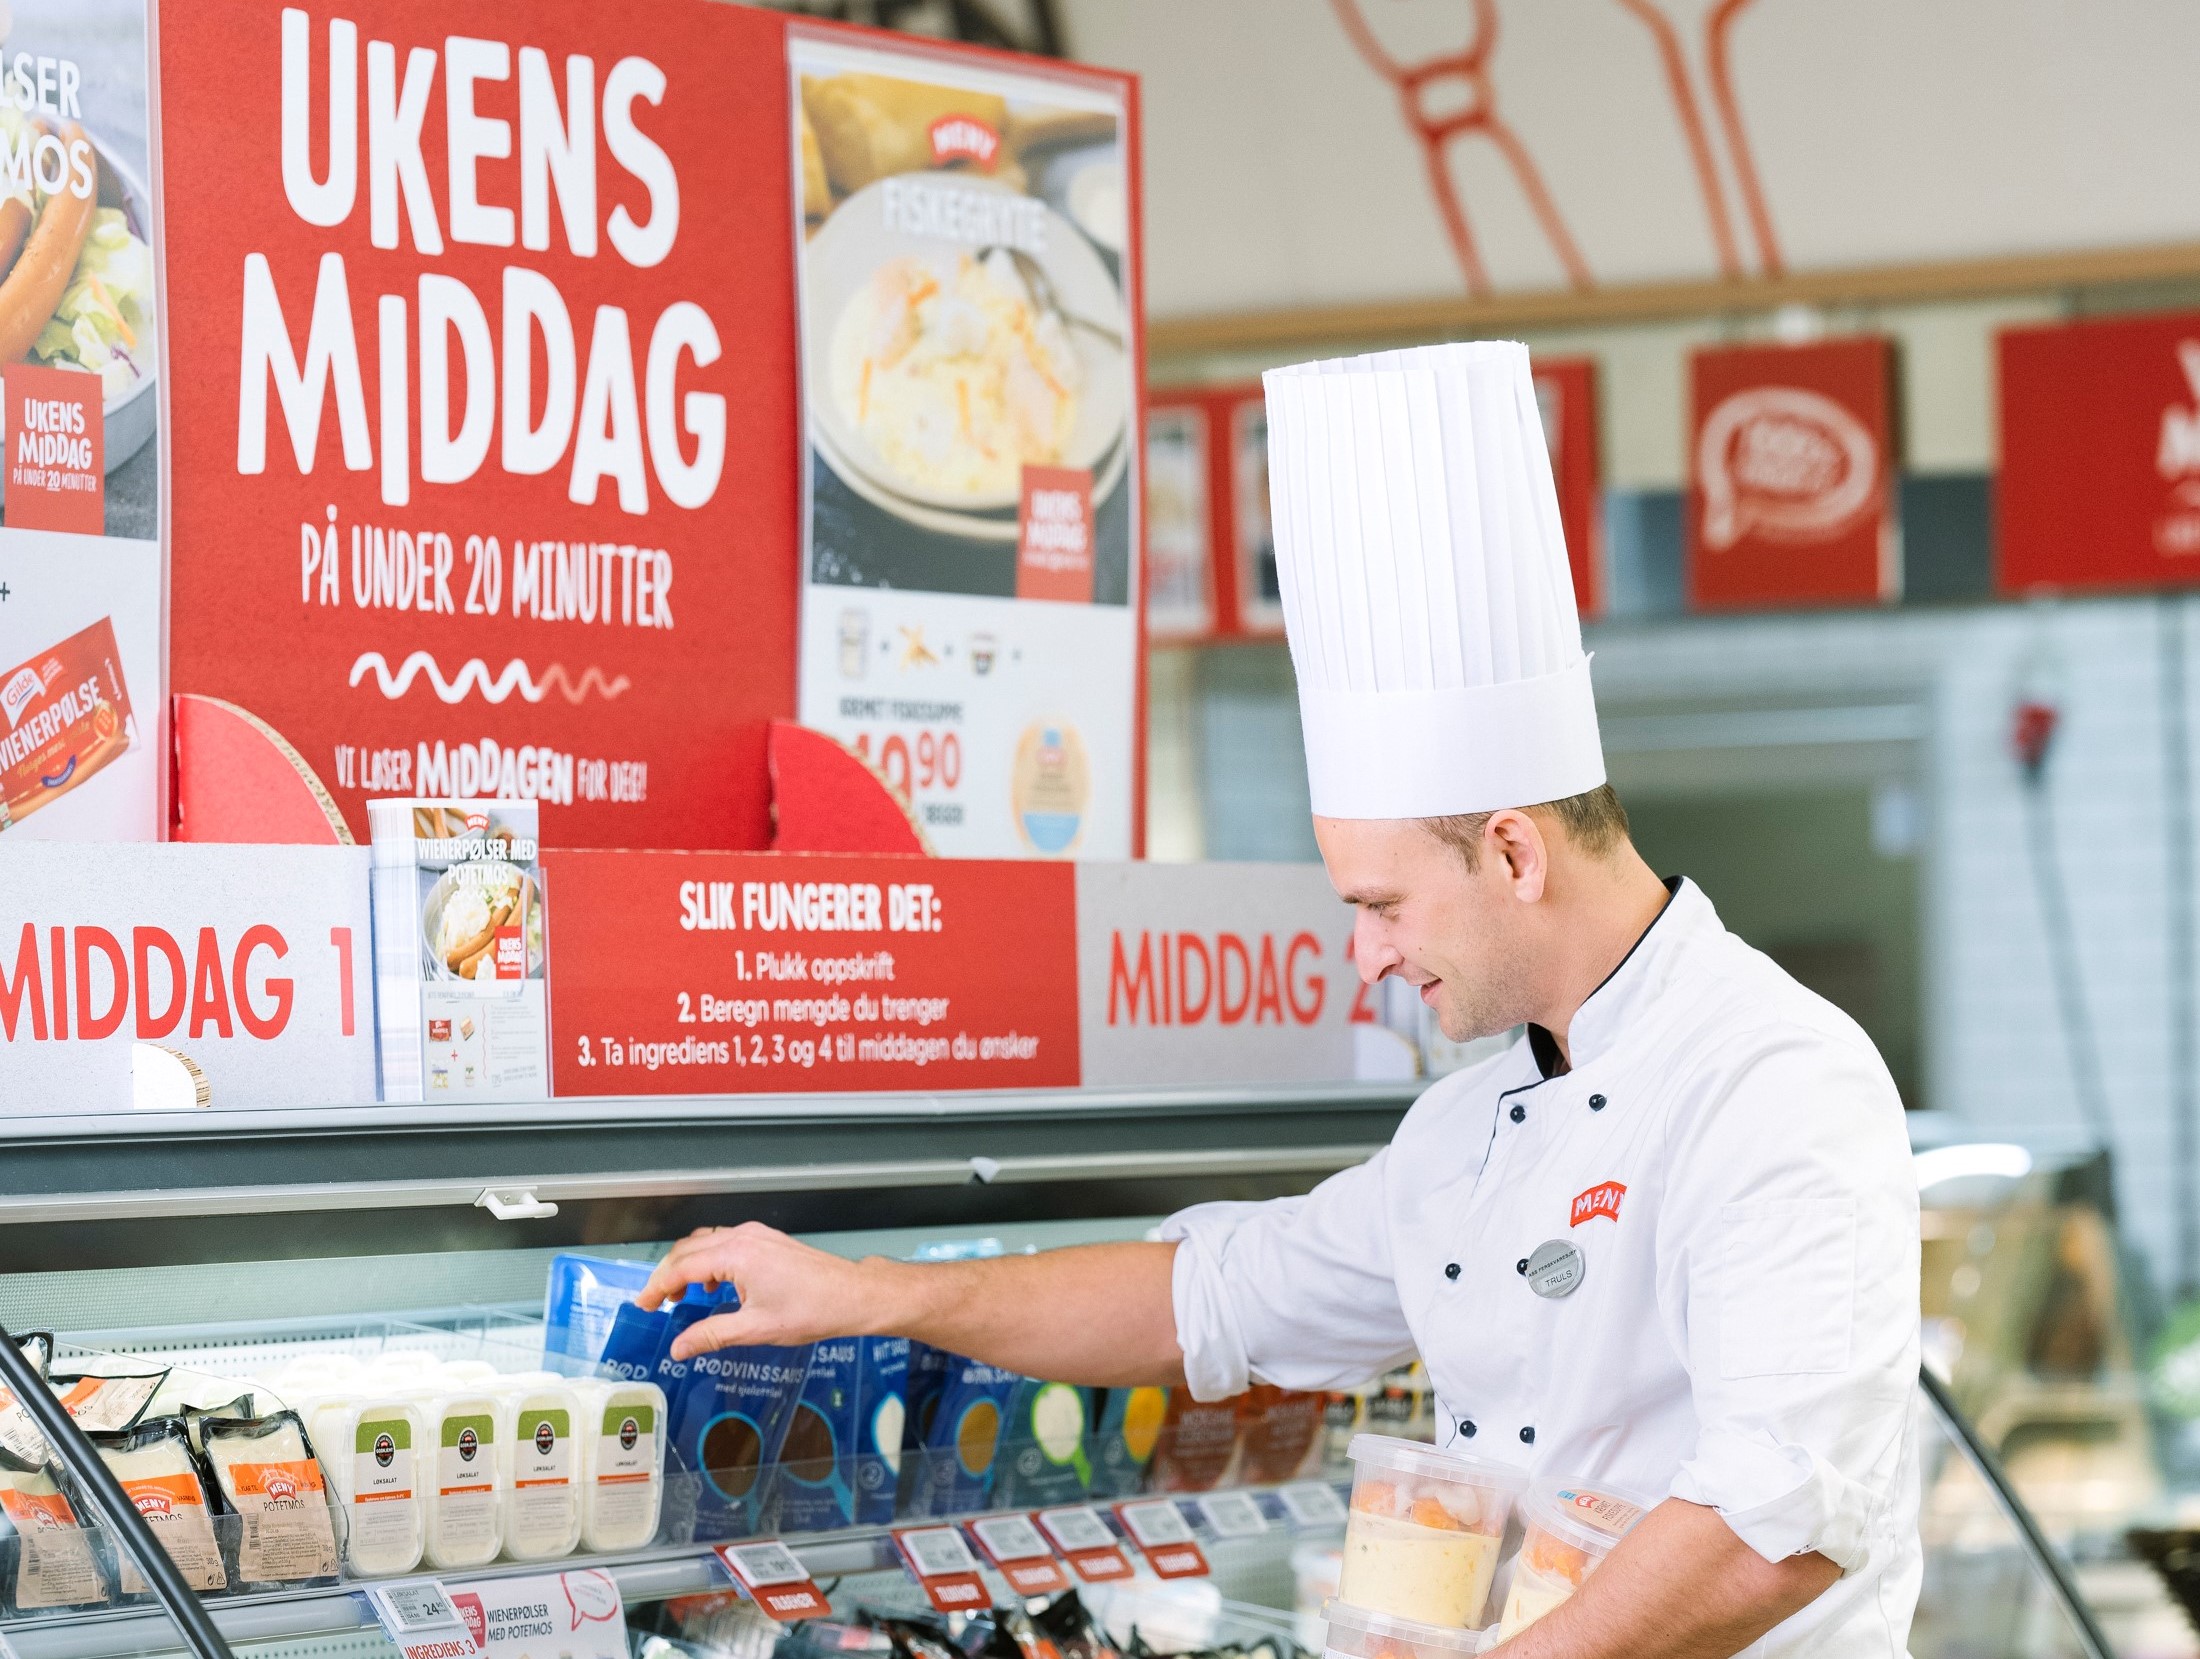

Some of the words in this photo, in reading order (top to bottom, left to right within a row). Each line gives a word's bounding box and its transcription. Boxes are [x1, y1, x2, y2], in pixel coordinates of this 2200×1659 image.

[281, 7, 681, 268] UKENS
[0, 126, 94, 200] MOS
[237, 252, 727, 516] MIDDAG
[24, 398, 86, 435] UKENS
[18, 431, 93, 471] MIDDAG
[23, 468, 46, 488] UNDER
[47, 469, 61, 492] 20
[61, 472, 97, 493] MINUTTER
[301, 503, 341, 608] PÅ
[351, 524, 456, 616] UNDER
[464, 534, 503, 617] 20
[512, 540, 675, 631] MINUTTER
[334, 743, 356, 789] VI
[416, 736, 574, 807] MIDDAGEN
[417, 837, 508, 861] WIENERPØLSER
[510, 838, 537, 861] MED
[447, 863, 510, 886] POTETMOS
[679, 880, 737, 931] SLIK
[742, 881, 883, 932] FUNGERER
[888, 883, 943, 932] DET:
[735, 950, 753, 981] 1.
[755, 952, 809, 982] Plukk
[811, 952, 896, 986] oppskrift
[1107, 928, 1328, 1027] MIDDAG
[0, 922, 295, 1043] MIDDAG
[330, 927, 356, 1037] 1
[677, 992, 697, 1023] 2.
[701, 994, 770, 1028] Beregn
[773, 992, 851, 1027] mengde
[853, 992, 879, 1023] du
[882, 995, 951, 1026] trenger
[577, 1036, 597, 1067] 3.
[601, 1036, 624, 1066] Ta
[628, 1036, 729, 1071] ingrediens
[788, 1036, 815, 1068] og
[817, 1034, 833, 1062] 4
[836, 1033, 856, 1061] til
[858, 1034, 950, 1067] middagen
[952, 1030, 978, 1061] du
[979, 1030, 1041, 1062] ønsker
[1545, 1269, 1573, 1287] TRULS
[692, 1356, 804, 1384] RØDVINSSAUS
[373, 1477, 397, 1486] LØKSALAT
[456, 1471, 479, 1479] LØKSALAT
[269, 1481, 294, 1496] MENY
[134, 1498, 167, 1512] MENY
[263, 1499, 306, 1513] POTETMOS
[422, 1602, 440, 1616] 24
[463, 1616, 481, 1628] DDAG
[486, 1603, 549, 1624] WIENERPØLSER
[487, 1627, 506, 1642] MED
[507, 1620, 553, 1639] POTETMOS
[404, 1640, 465, 1659] INGREDIENS
[465, 1639, 476, 1655] 3
